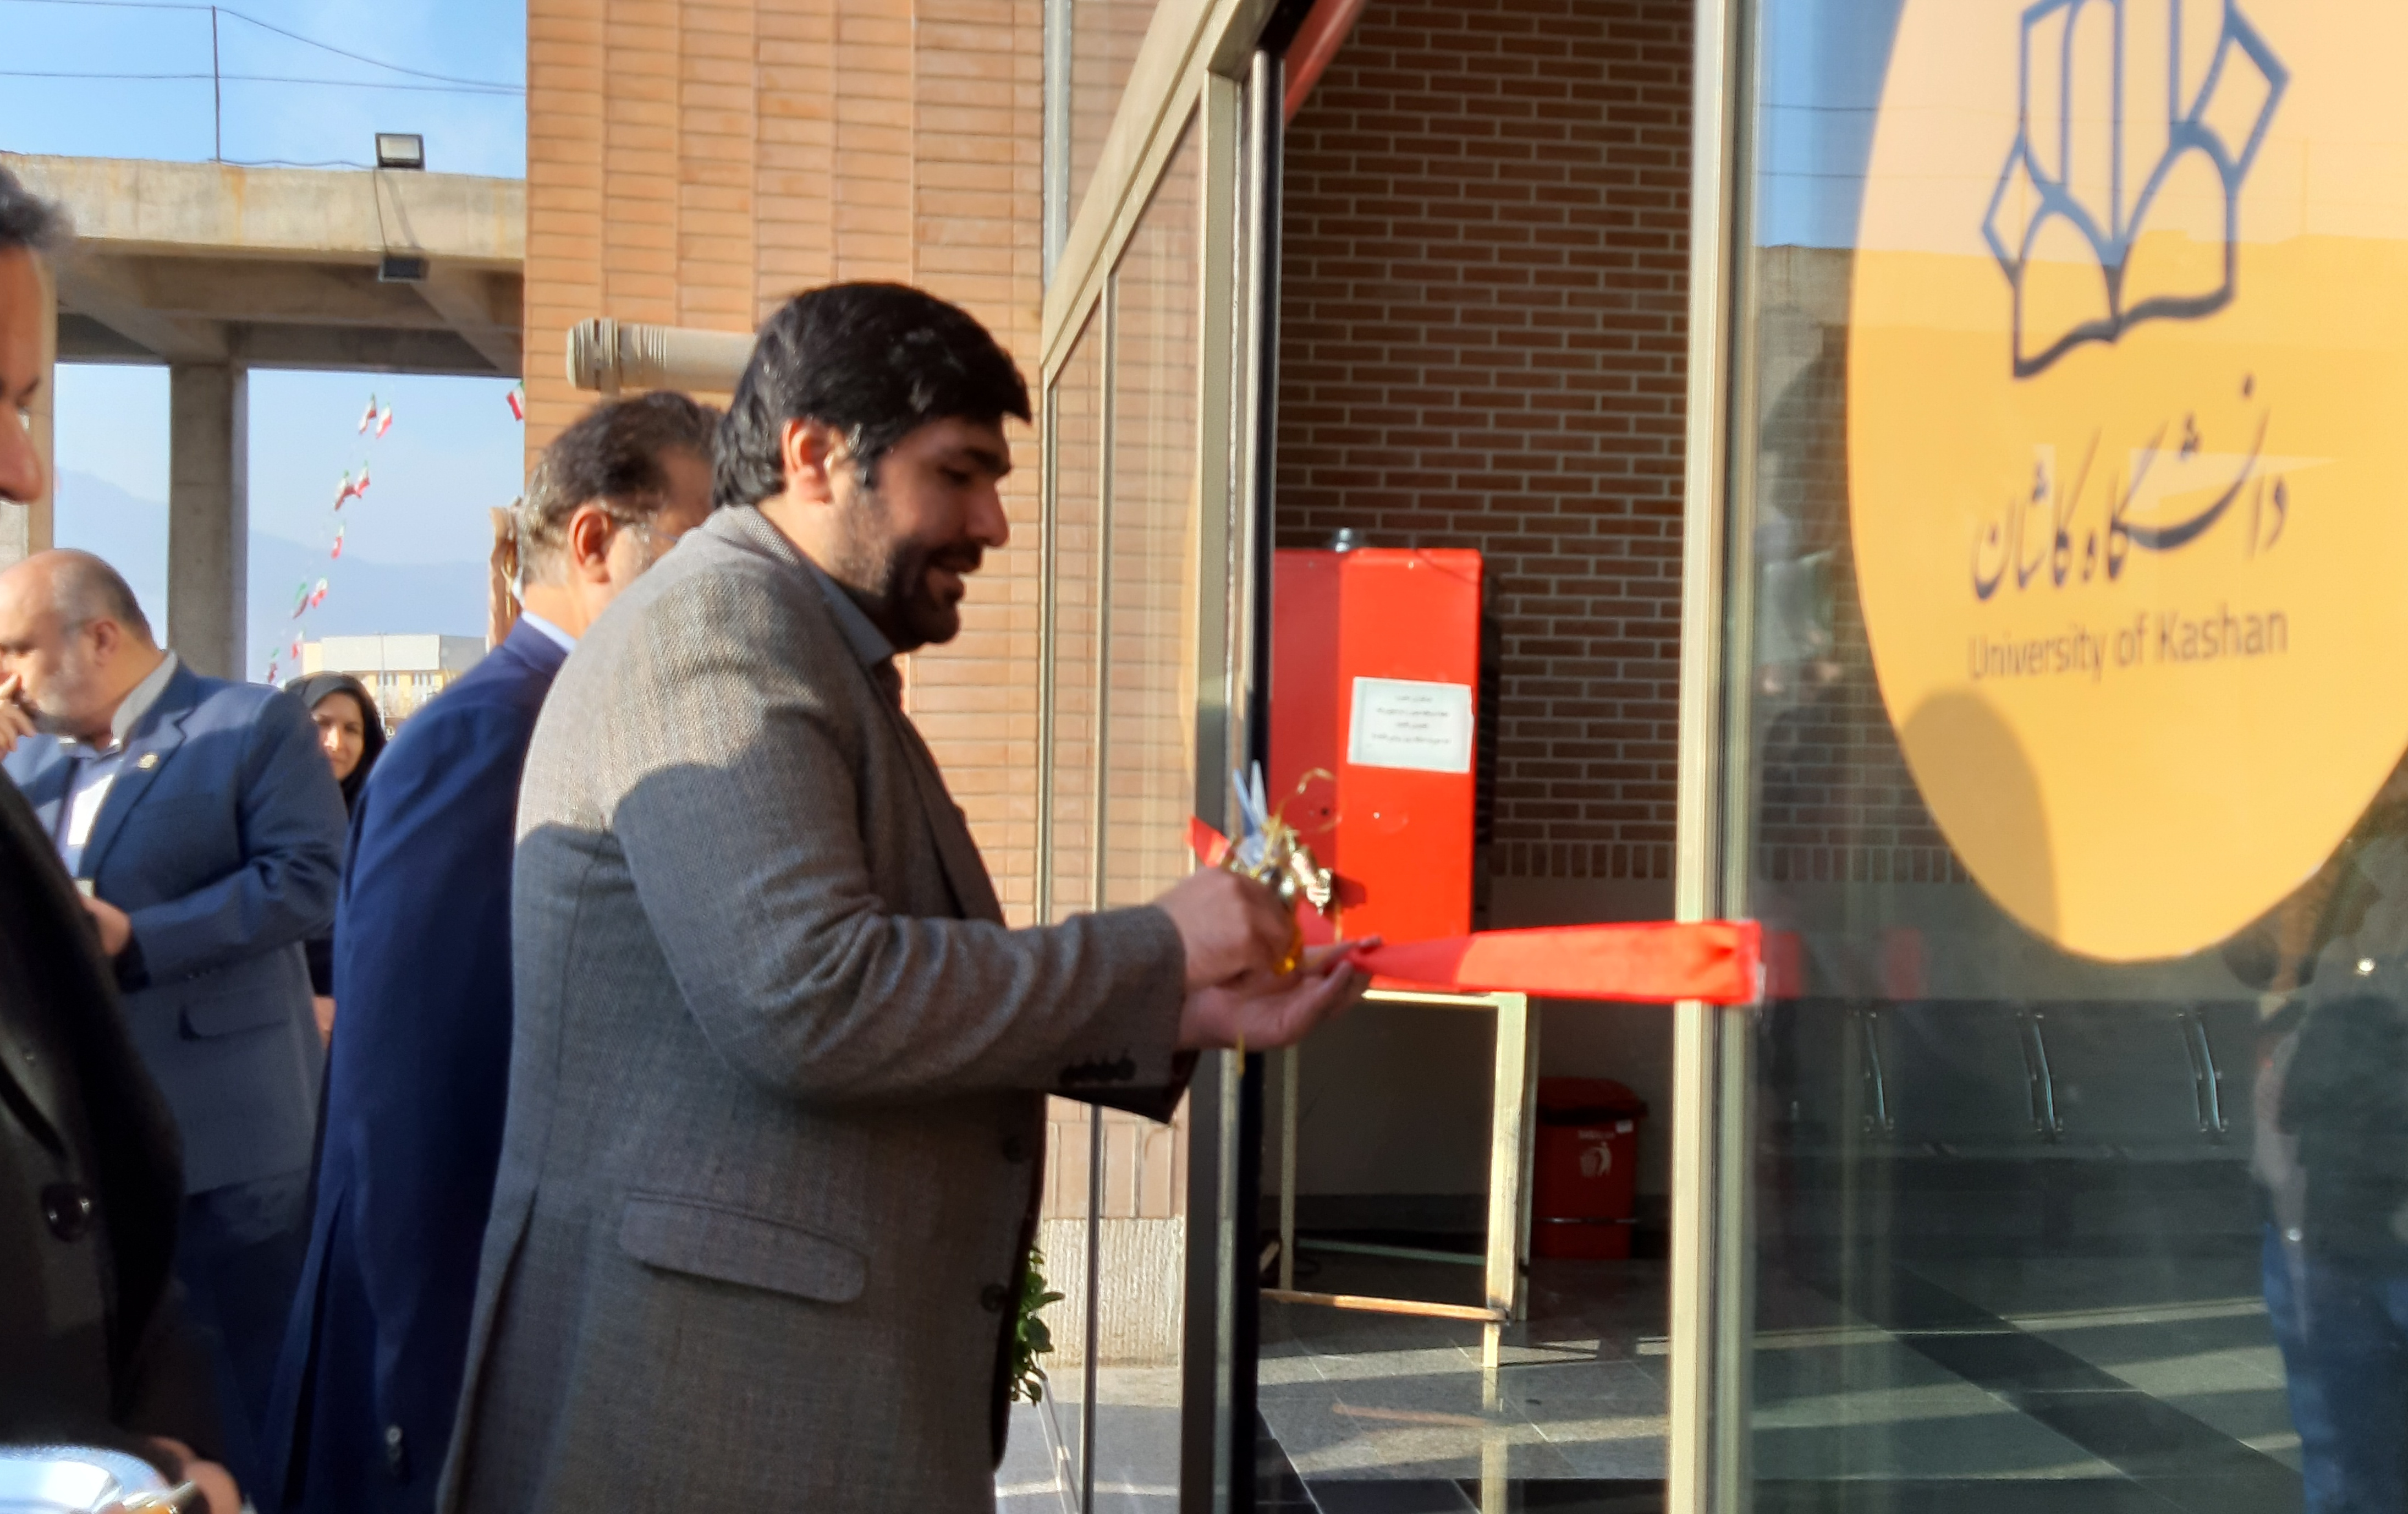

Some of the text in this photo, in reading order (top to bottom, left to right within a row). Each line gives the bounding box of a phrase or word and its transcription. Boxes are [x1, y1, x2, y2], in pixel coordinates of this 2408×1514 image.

[1971, 372, 2289, 602] دانشگاه کاشان
[1968, 602, 2289, 683] University of Kashan
